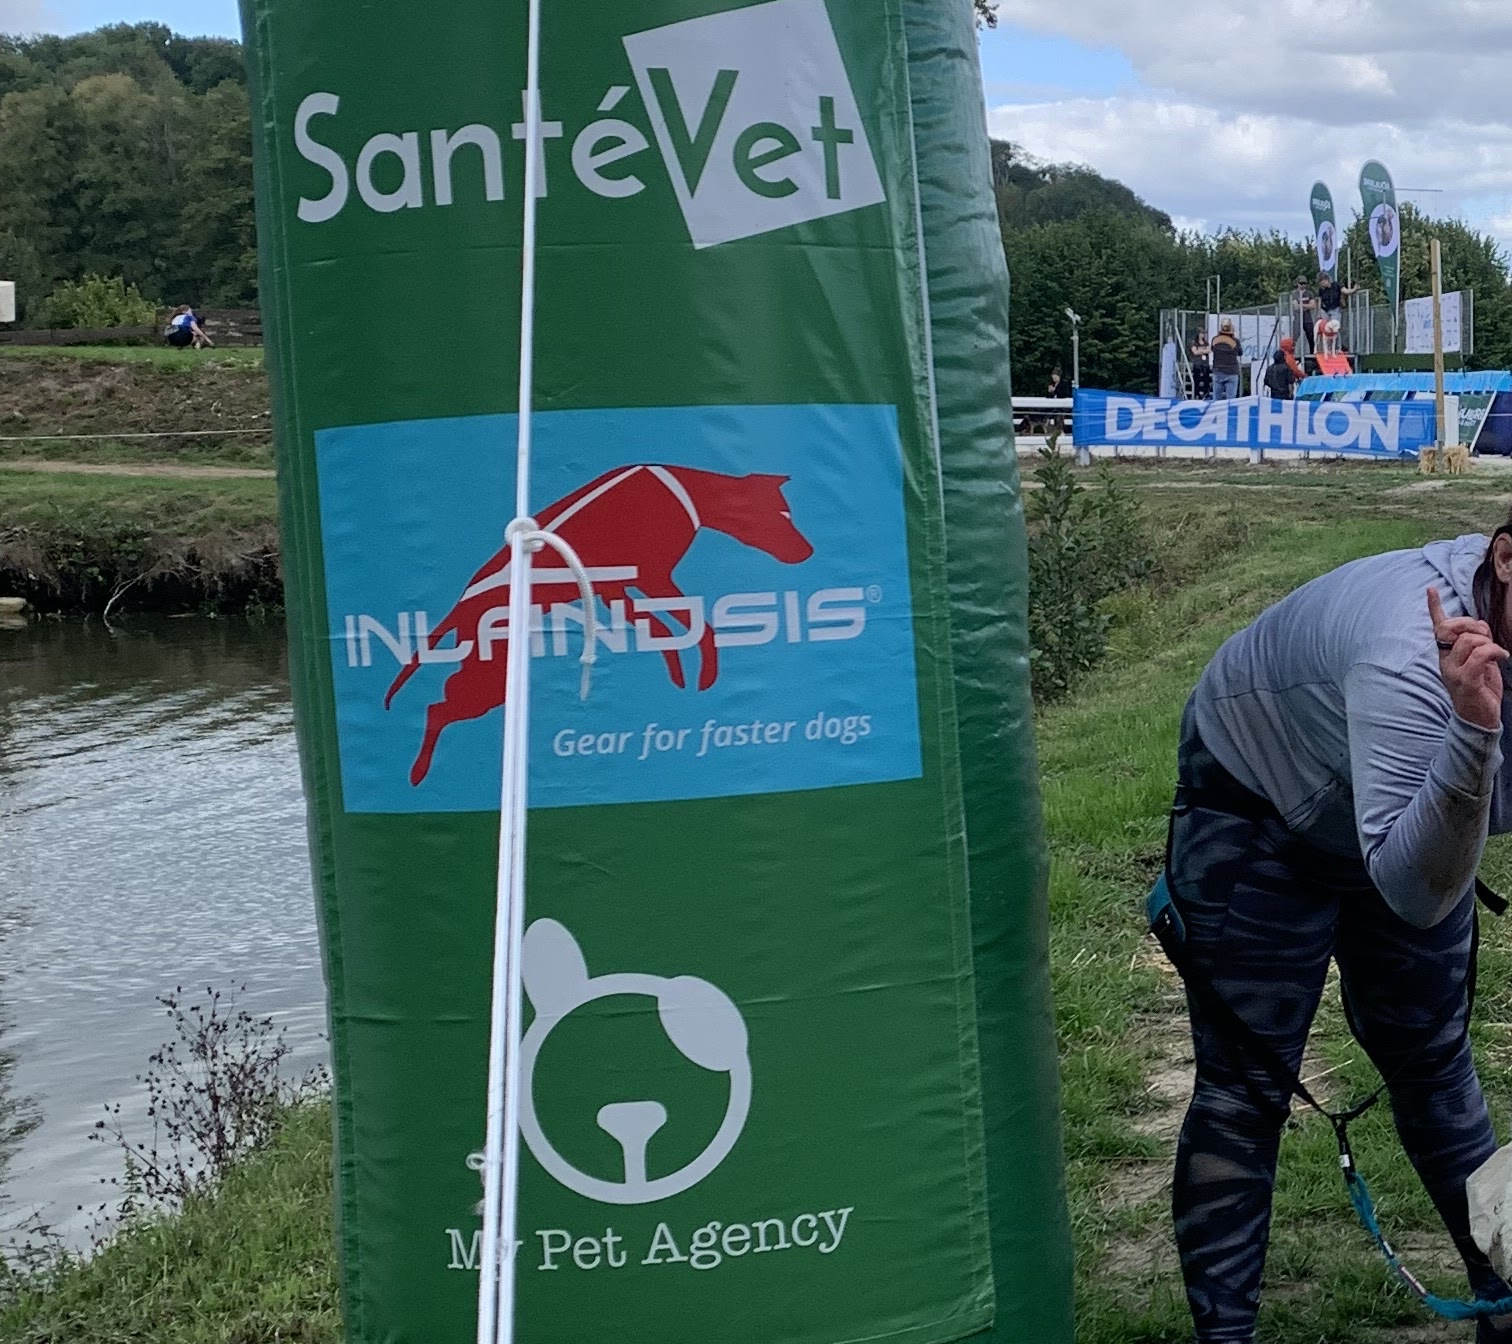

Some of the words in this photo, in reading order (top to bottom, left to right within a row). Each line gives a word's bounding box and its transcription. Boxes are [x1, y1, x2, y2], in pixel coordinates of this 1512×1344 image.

[1105, 396, 1401, 451] DECATHLON
[553, 728, 633, 756] Gear
[637, 723, 691, 760] for
[696, 719, 797, 758] faster
[805, 712, 872, 745] dogs
[538, 1226, 626, 1271] Pet
[641, 1207, 854, 1270] Agency
